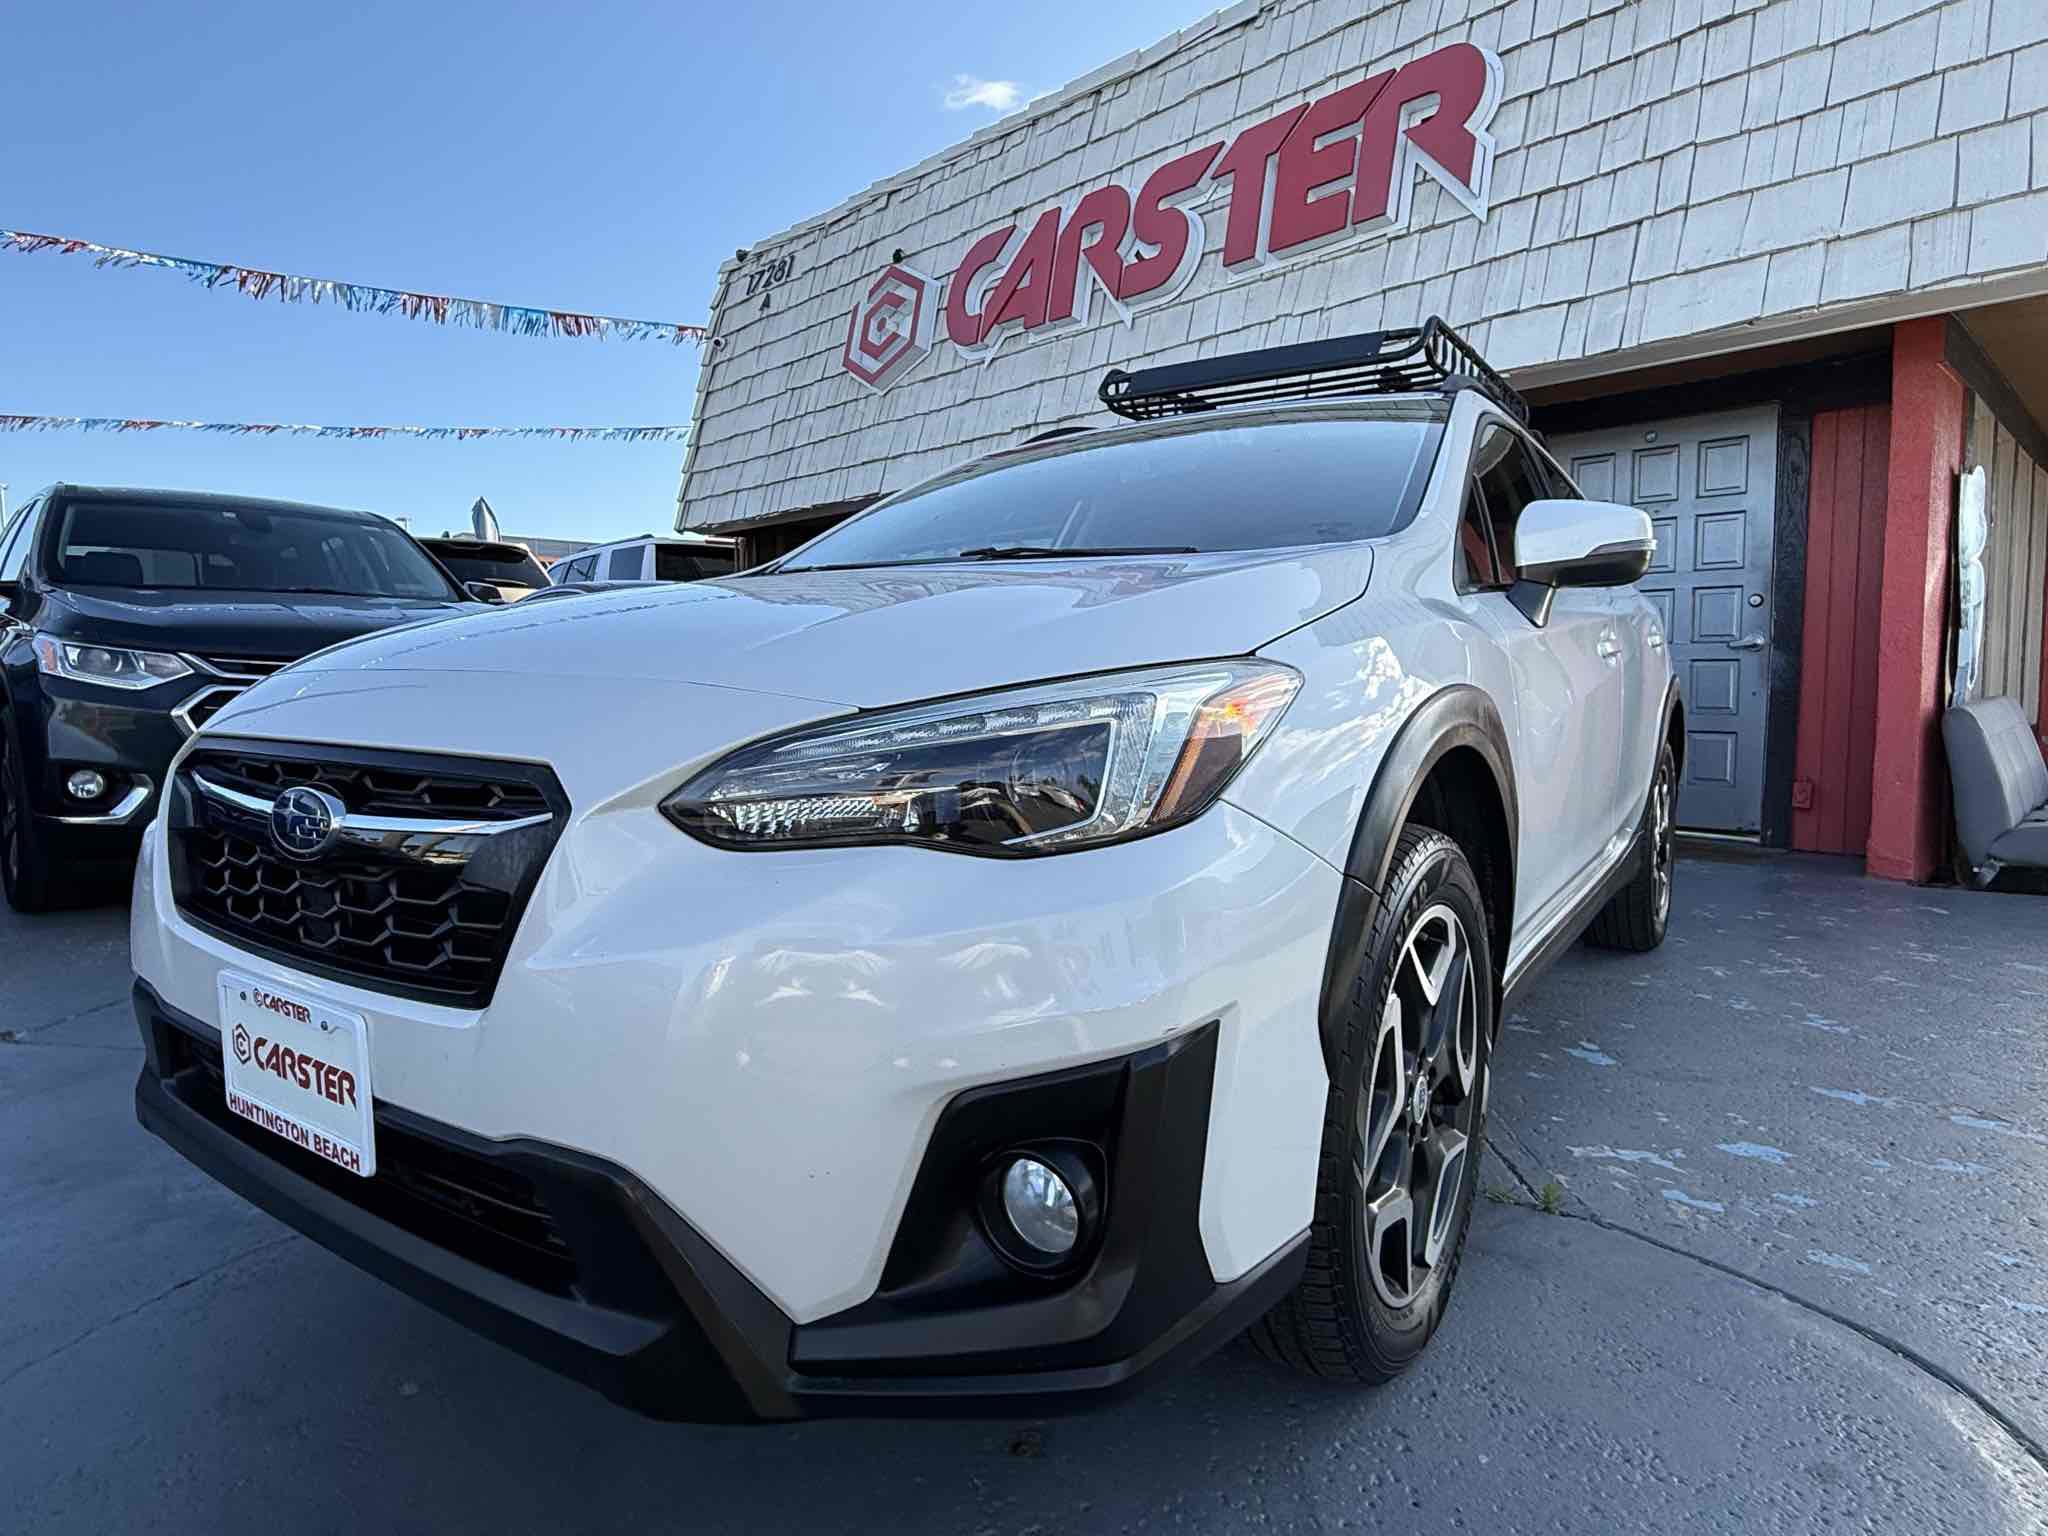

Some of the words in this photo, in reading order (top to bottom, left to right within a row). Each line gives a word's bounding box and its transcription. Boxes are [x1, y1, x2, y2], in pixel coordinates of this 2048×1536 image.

[946, 42, 1491, 349] CARSTER
[745, 255, 795, 296] 17281
[758, 293, 771, 312] A
[263, 993, 312, 1024] CARSTER
[253, 1036, 358, 1111] CARSTER
[229, 1092, 310, 1149] HUNTINGTON
[313, 1133, 361, 1173] BEACH
